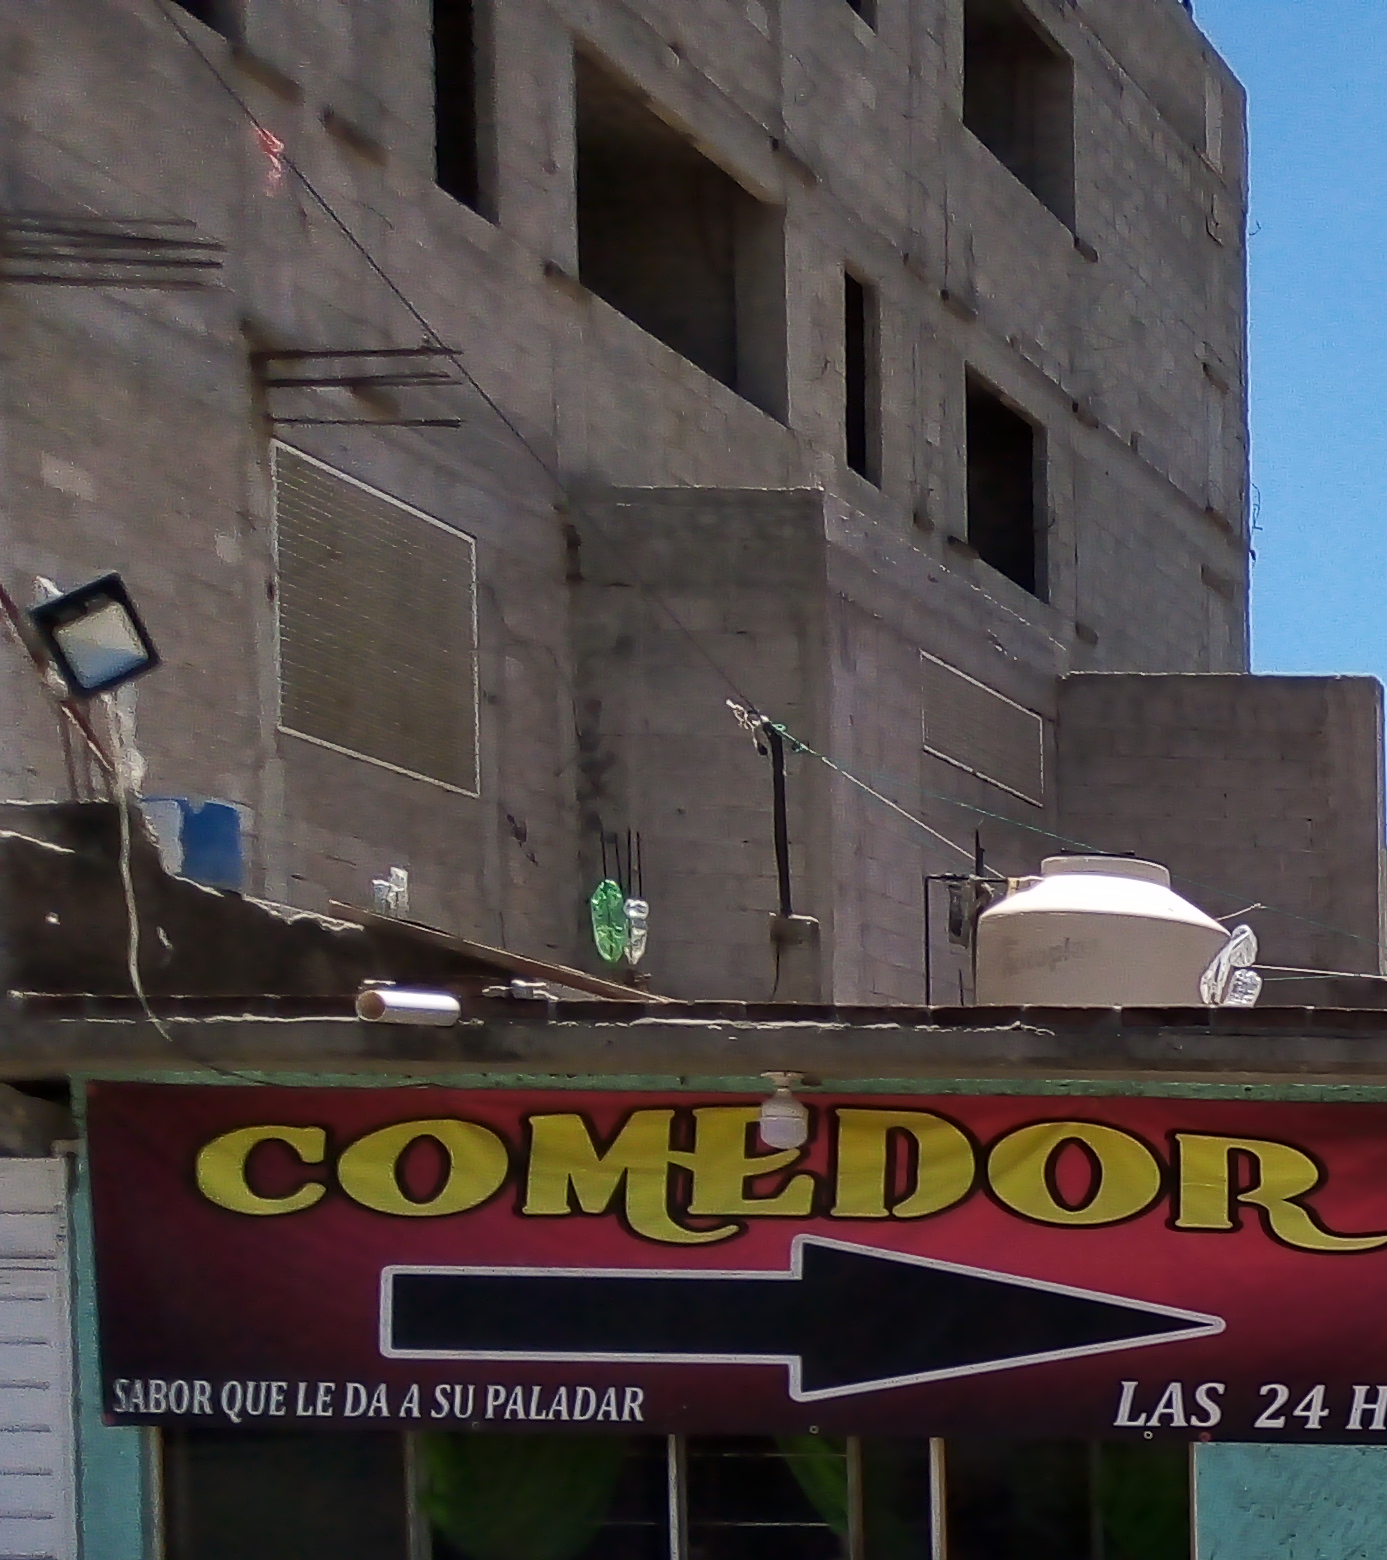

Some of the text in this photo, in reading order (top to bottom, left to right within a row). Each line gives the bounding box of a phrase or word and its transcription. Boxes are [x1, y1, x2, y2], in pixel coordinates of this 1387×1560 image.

[113, 1378, 645, 1424] SABOR QUE LE DA A SU PALADAR
[1112, 1380, 1226, 1428] LAS
[1253, 1383, 1330, 1430] 24
